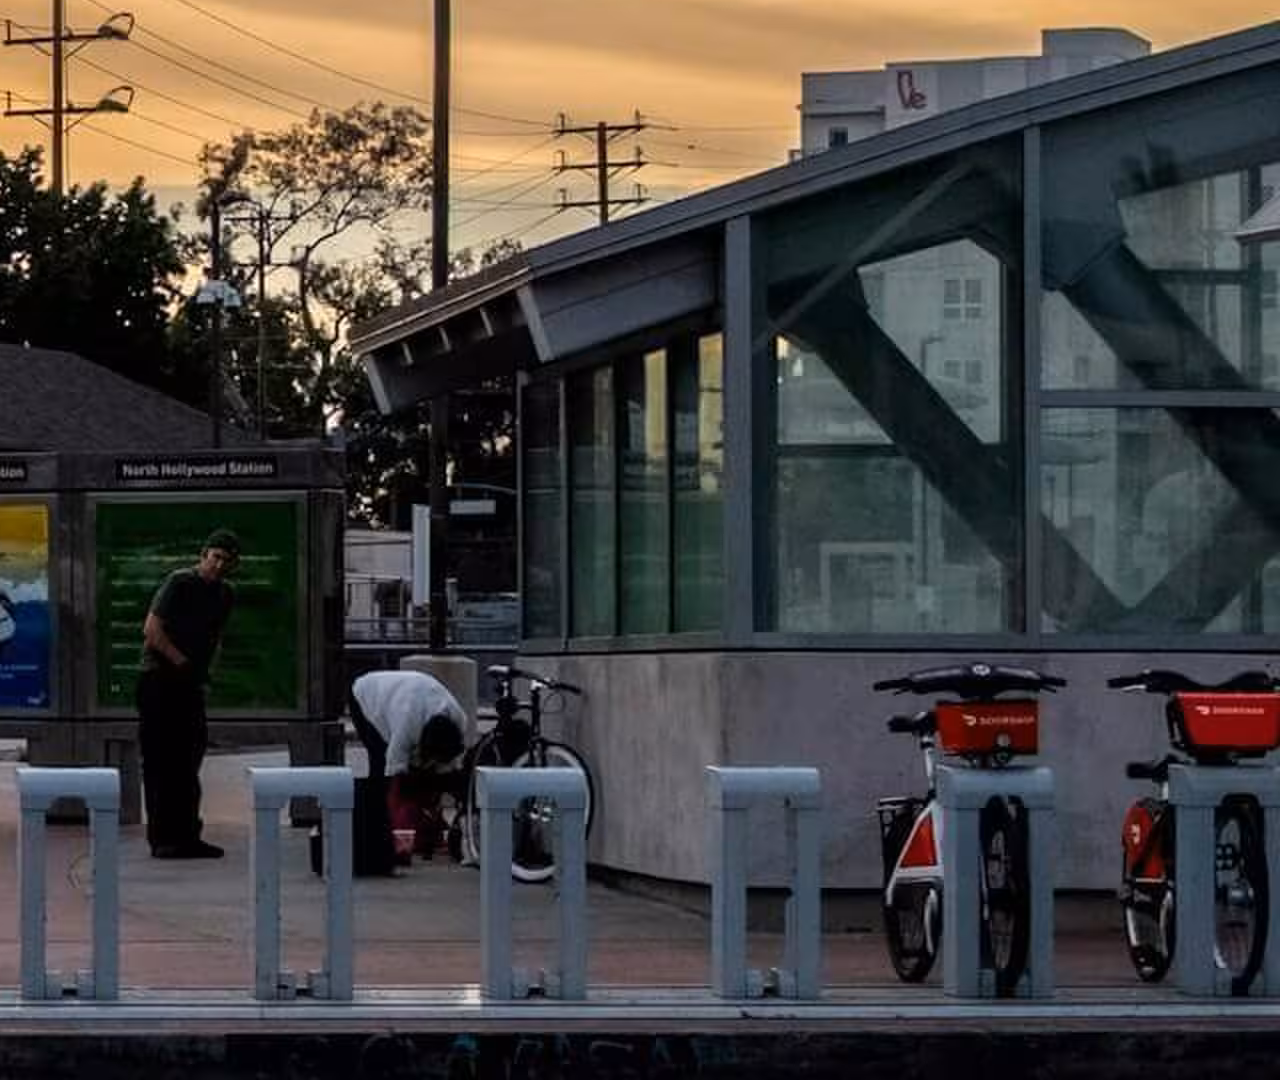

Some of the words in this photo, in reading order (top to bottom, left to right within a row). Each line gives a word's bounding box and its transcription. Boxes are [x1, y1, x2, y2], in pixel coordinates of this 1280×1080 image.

[122, 463, 159, 477] North
[161, 461, 226, 478] Hollywood
[229, 460, 273, 475] Station
